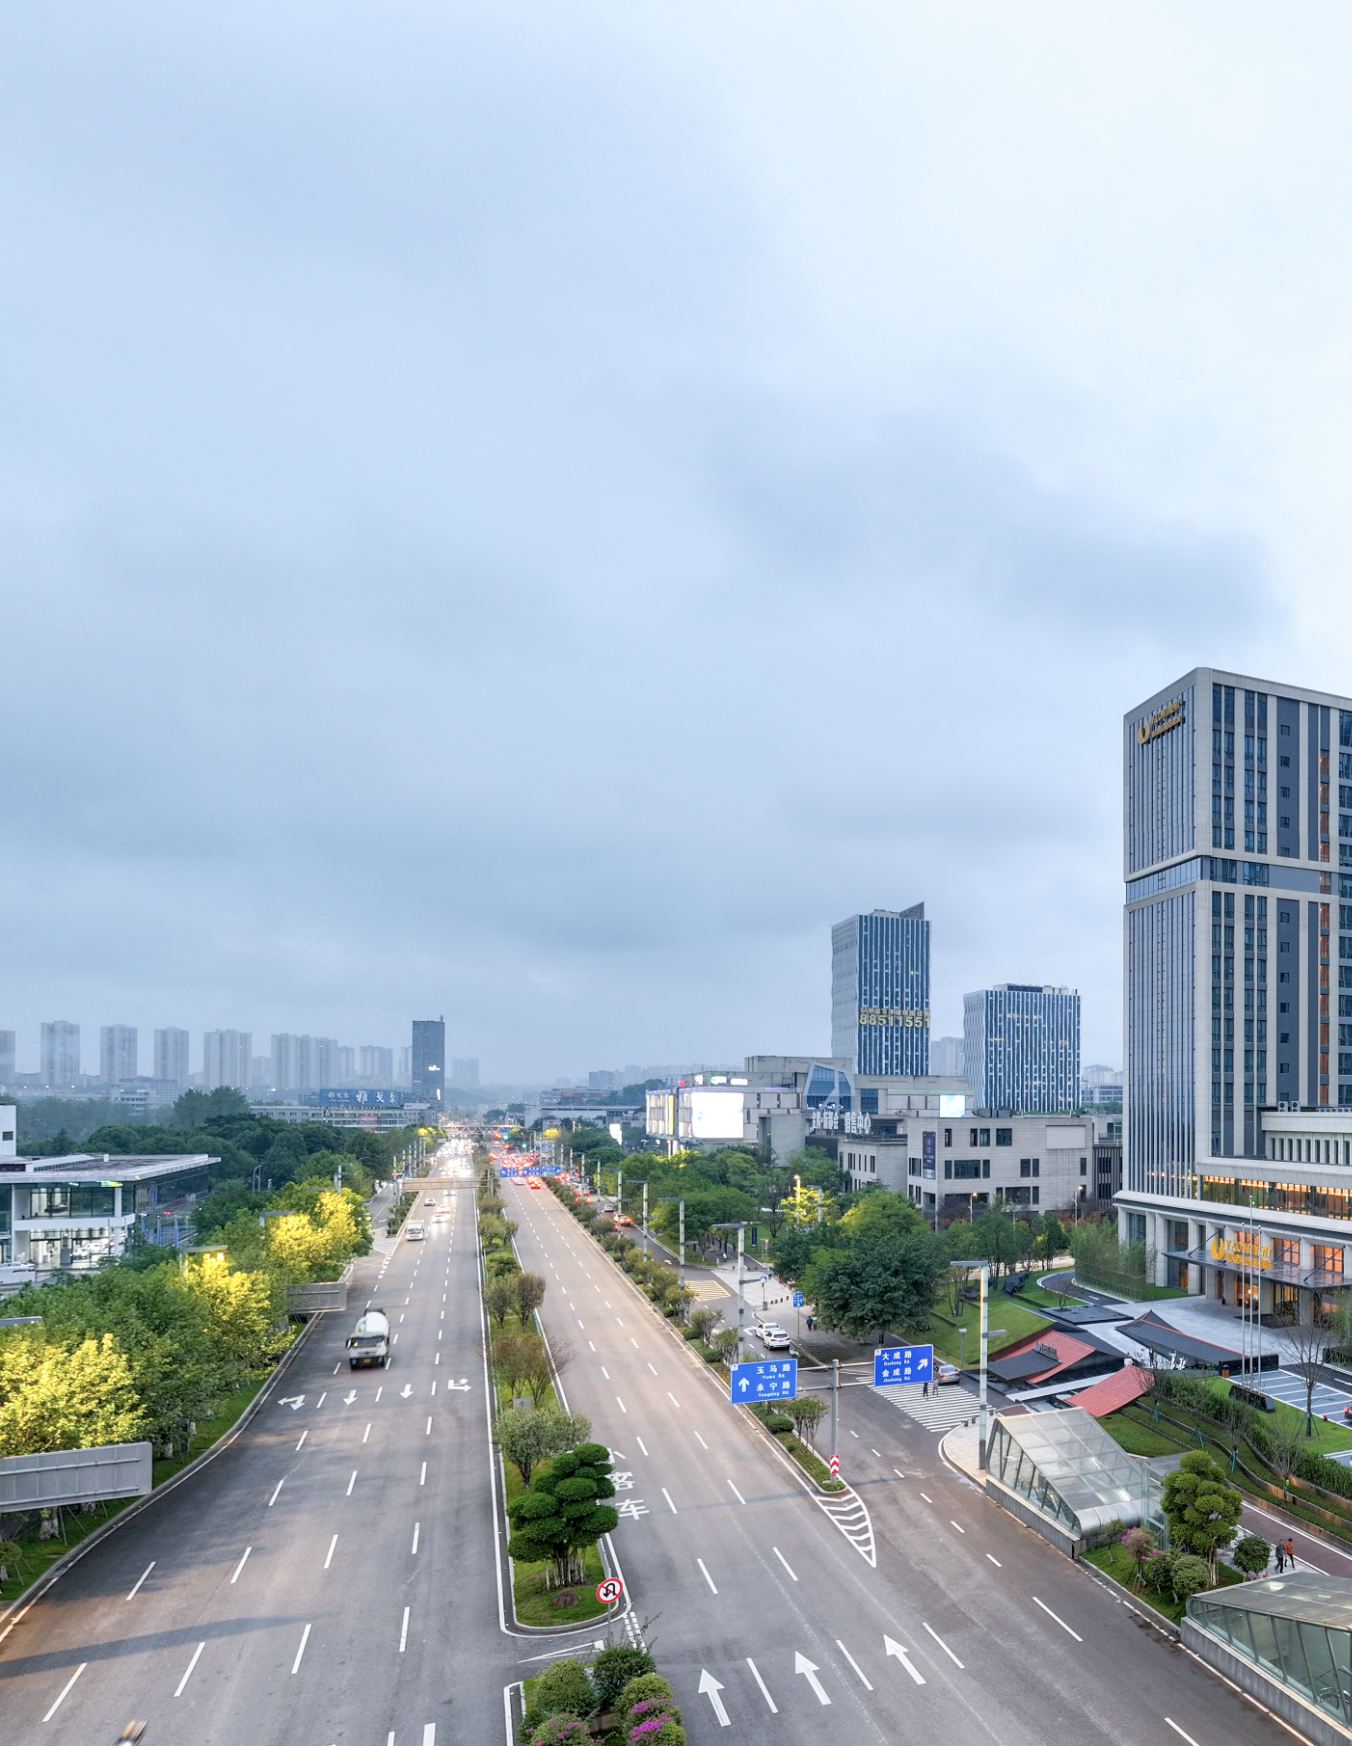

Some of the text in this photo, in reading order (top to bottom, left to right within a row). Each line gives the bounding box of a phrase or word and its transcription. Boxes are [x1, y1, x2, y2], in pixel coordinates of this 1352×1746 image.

[860, 1013, 930, 1028] 88511551
[756, 1380, 791, 1392] 永宁路
